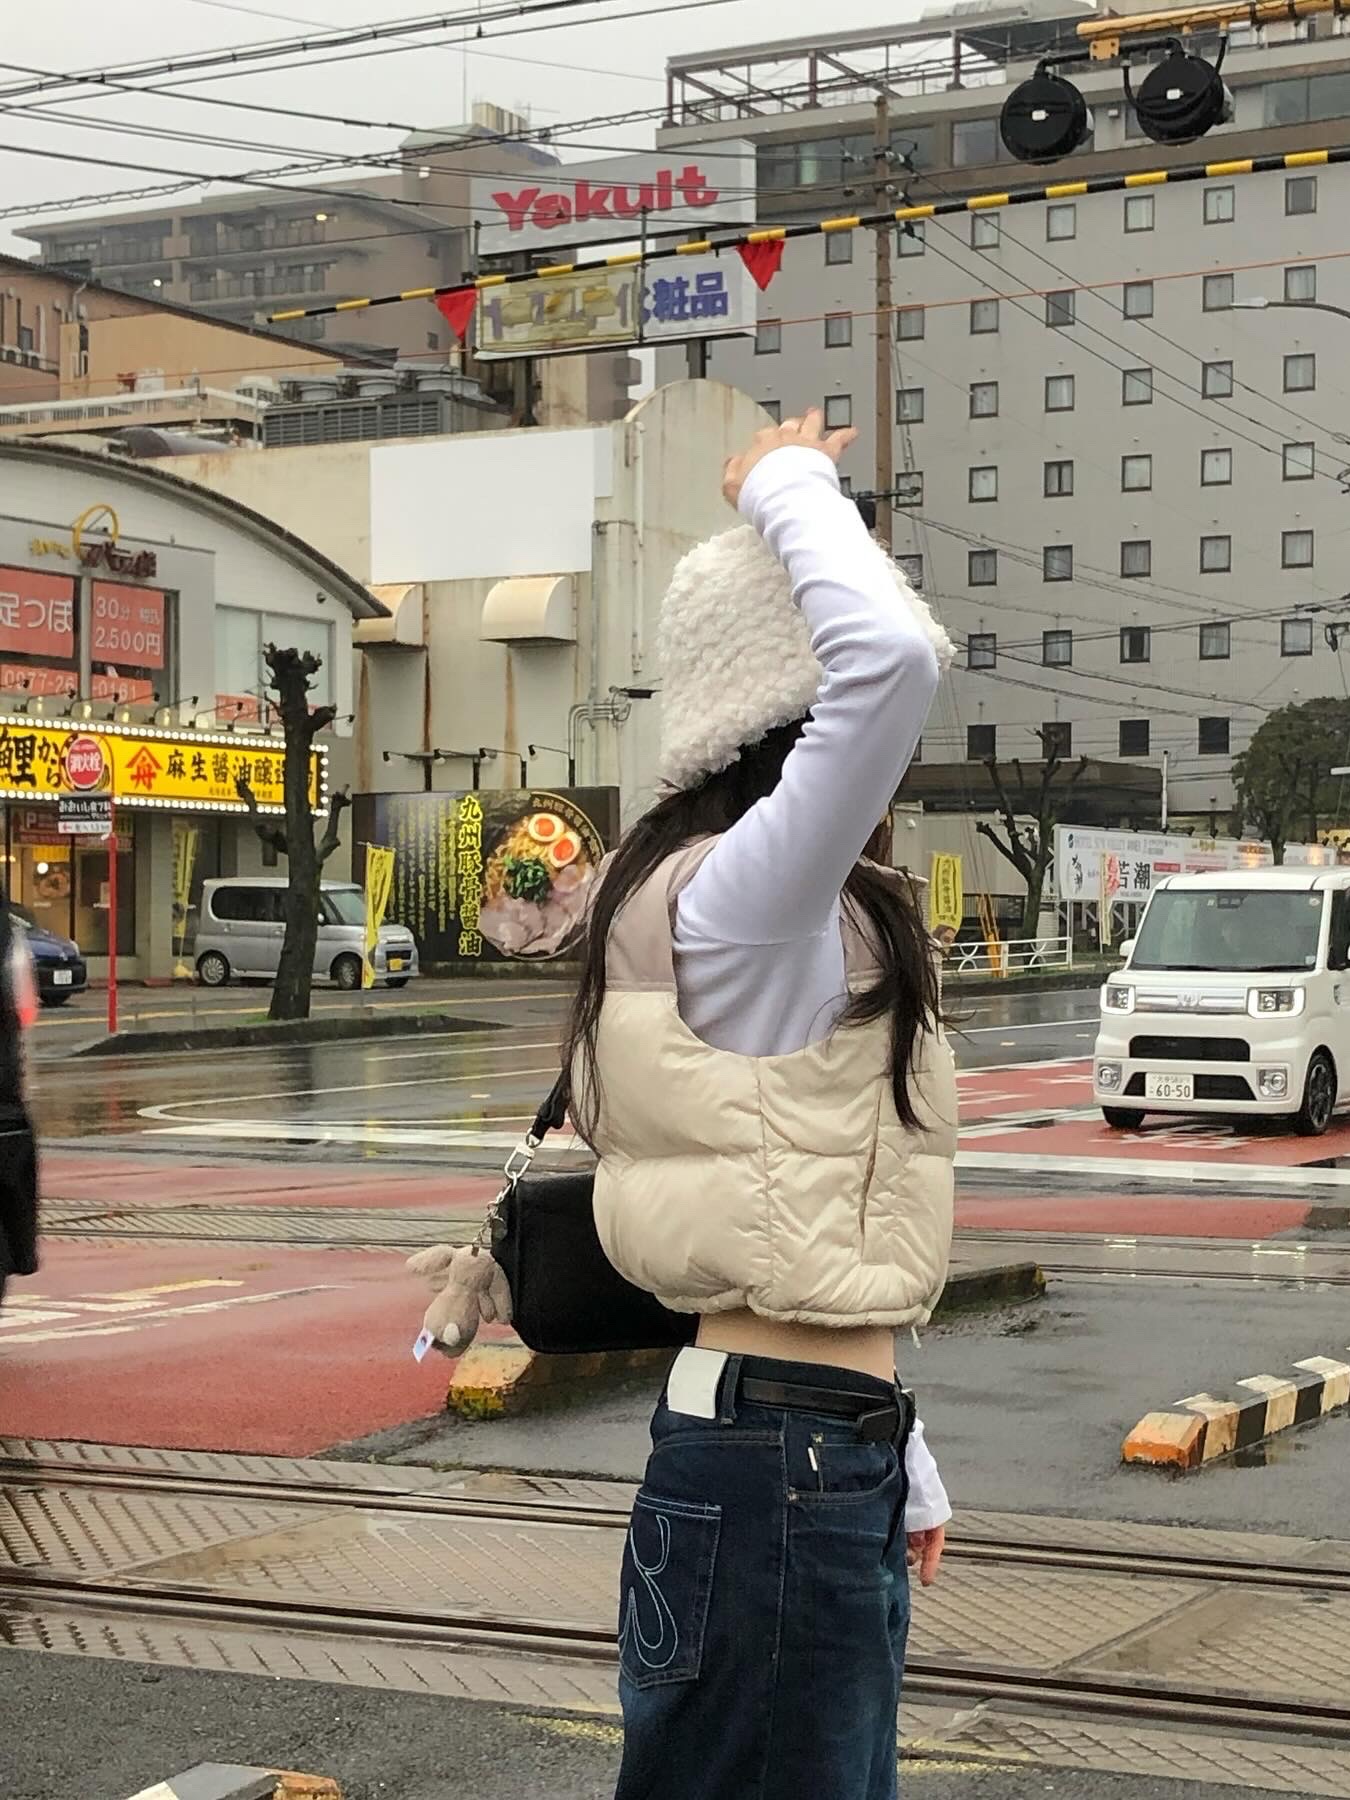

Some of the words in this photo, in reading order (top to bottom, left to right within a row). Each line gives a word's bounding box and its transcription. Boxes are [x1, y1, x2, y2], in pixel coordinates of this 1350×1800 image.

[491, 165, 720, 232] Yakult
[70, 752, 101, 772] 消火栓
[166, 748, 313, 787] 麻生醤油醸
[458, 796, 483, 956] 九州豚骨醤油
[1156, 1084, 1191, 1098] 60-50
